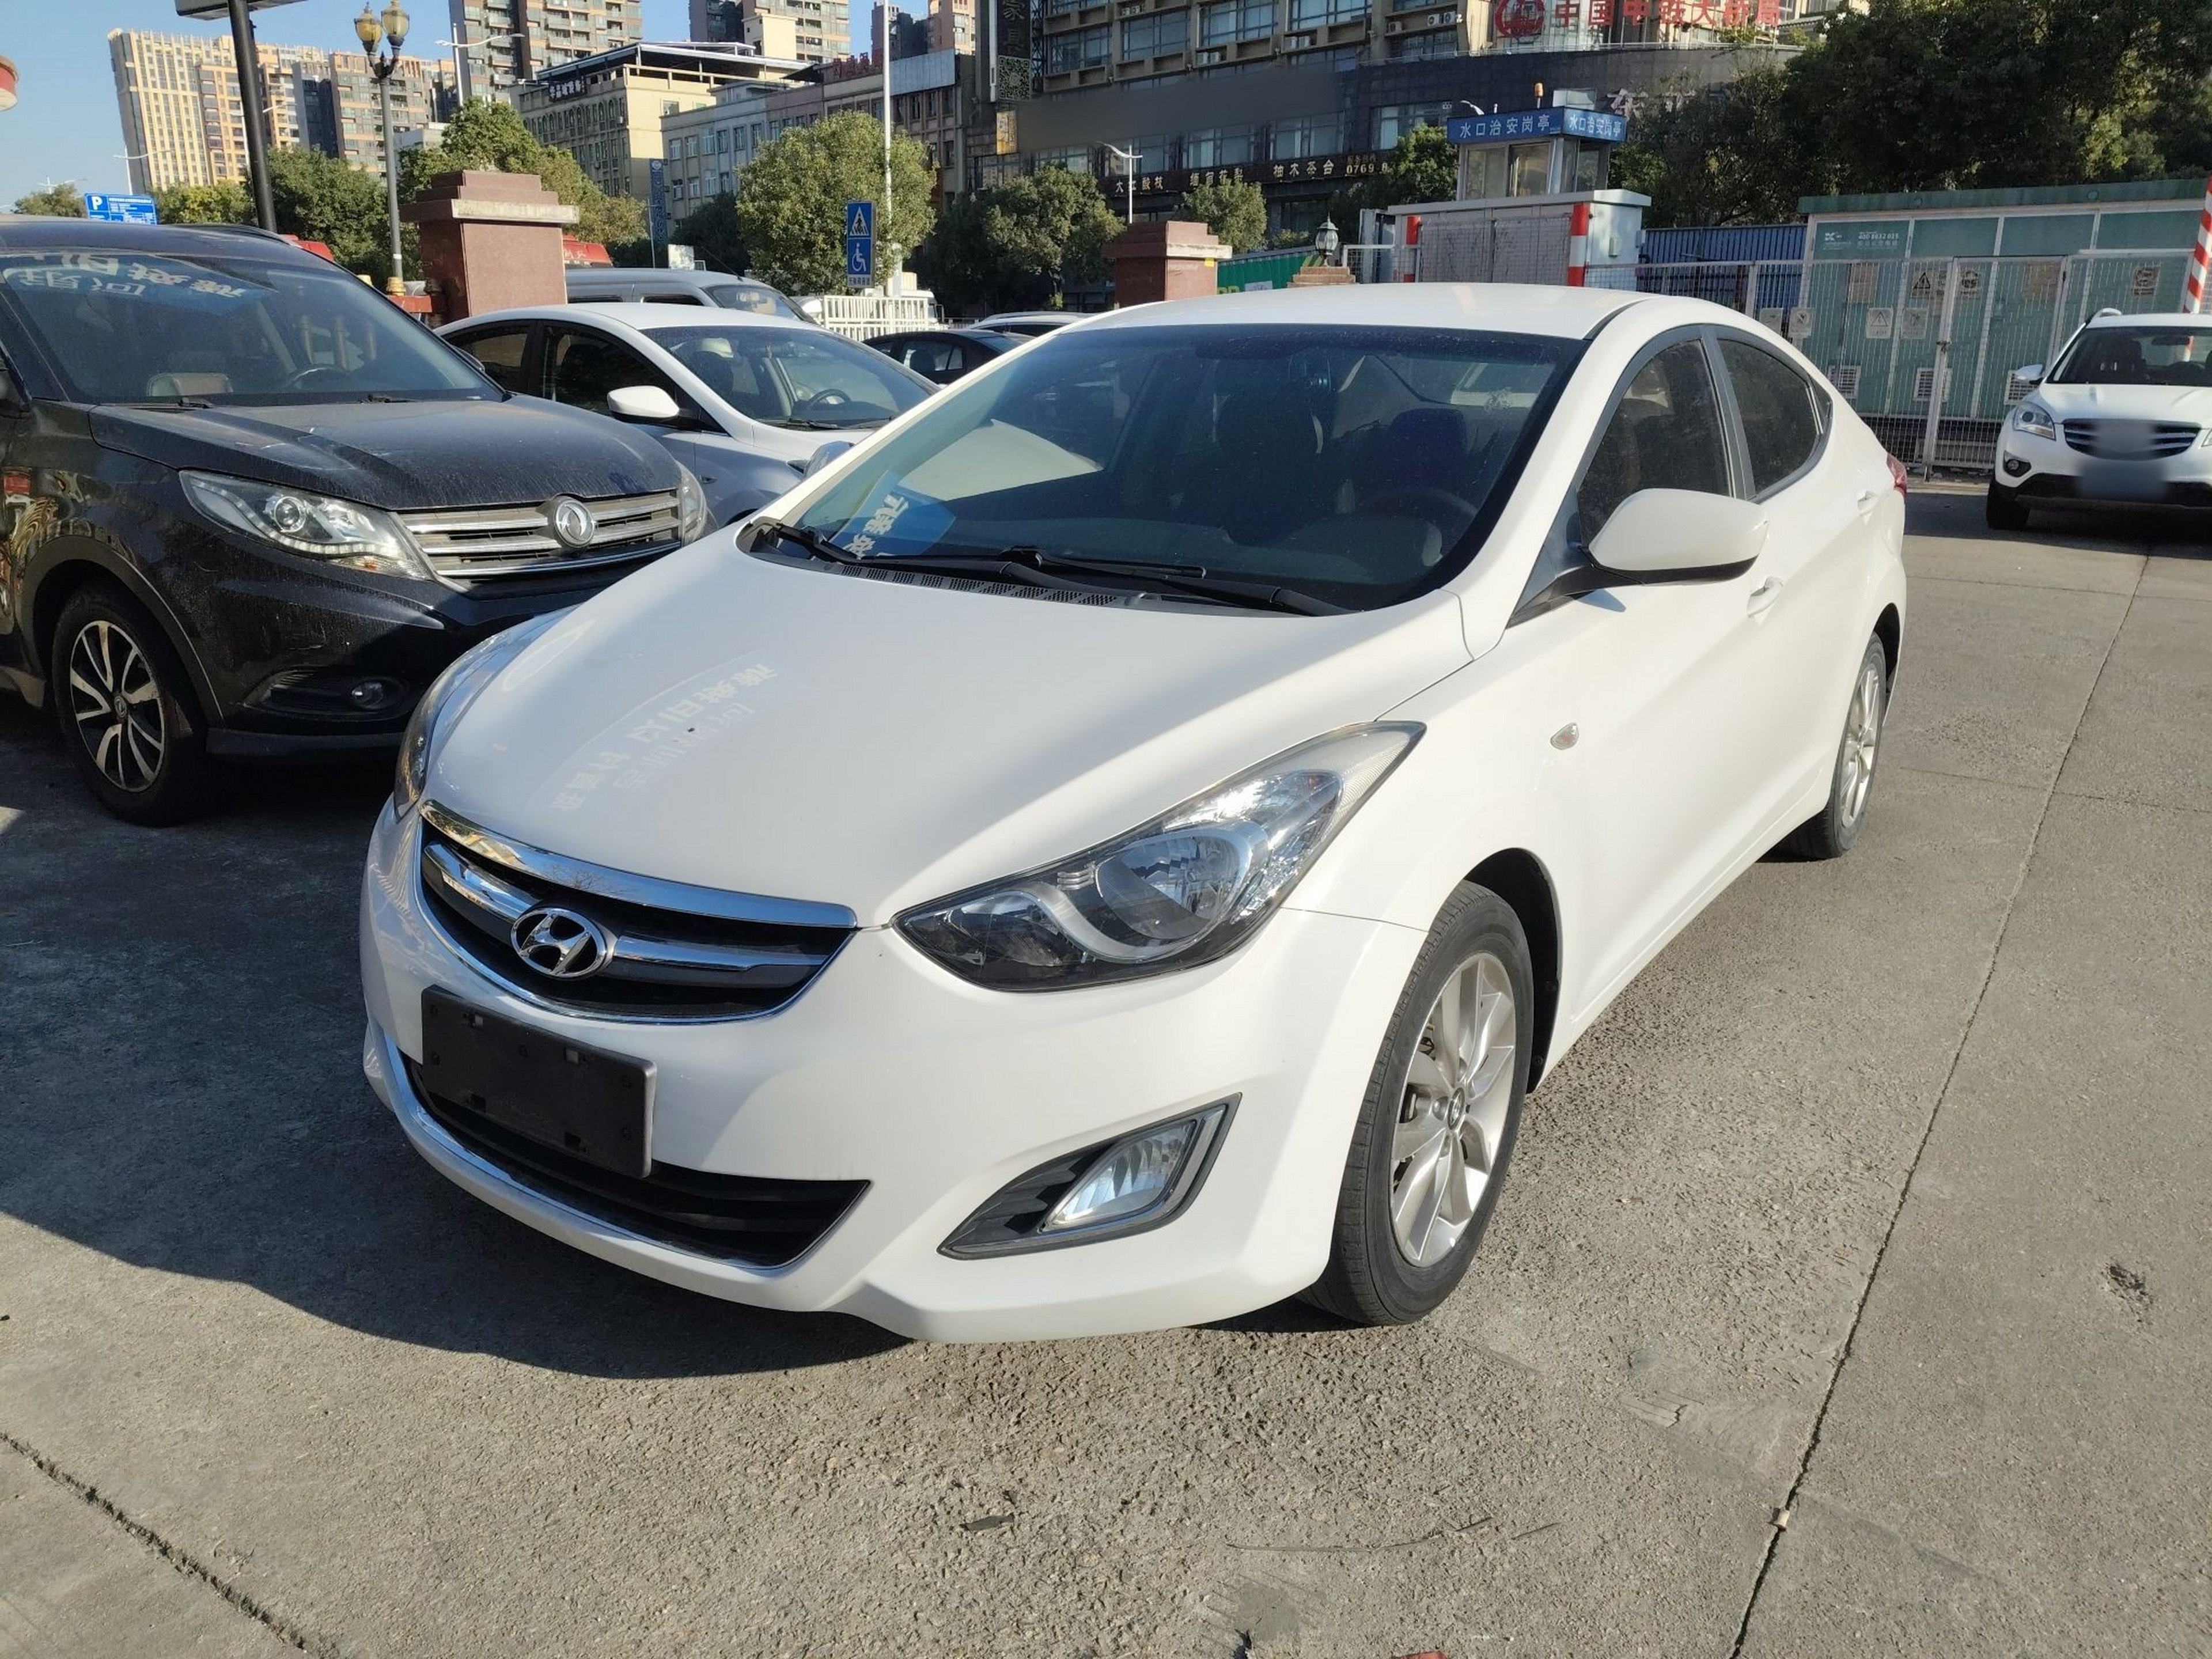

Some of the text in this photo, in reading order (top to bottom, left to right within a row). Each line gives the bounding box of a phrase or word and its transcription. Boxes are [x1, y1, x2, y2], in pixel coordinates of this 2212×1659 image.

[1556, 0, 1781, 28] 中国中铁大桥局
[1460, 114, 1550, 138] 水口治安岗亭
[1570, 115, 1622, 137] 水口治安岗亭
[91, 196, 103, 210] P
